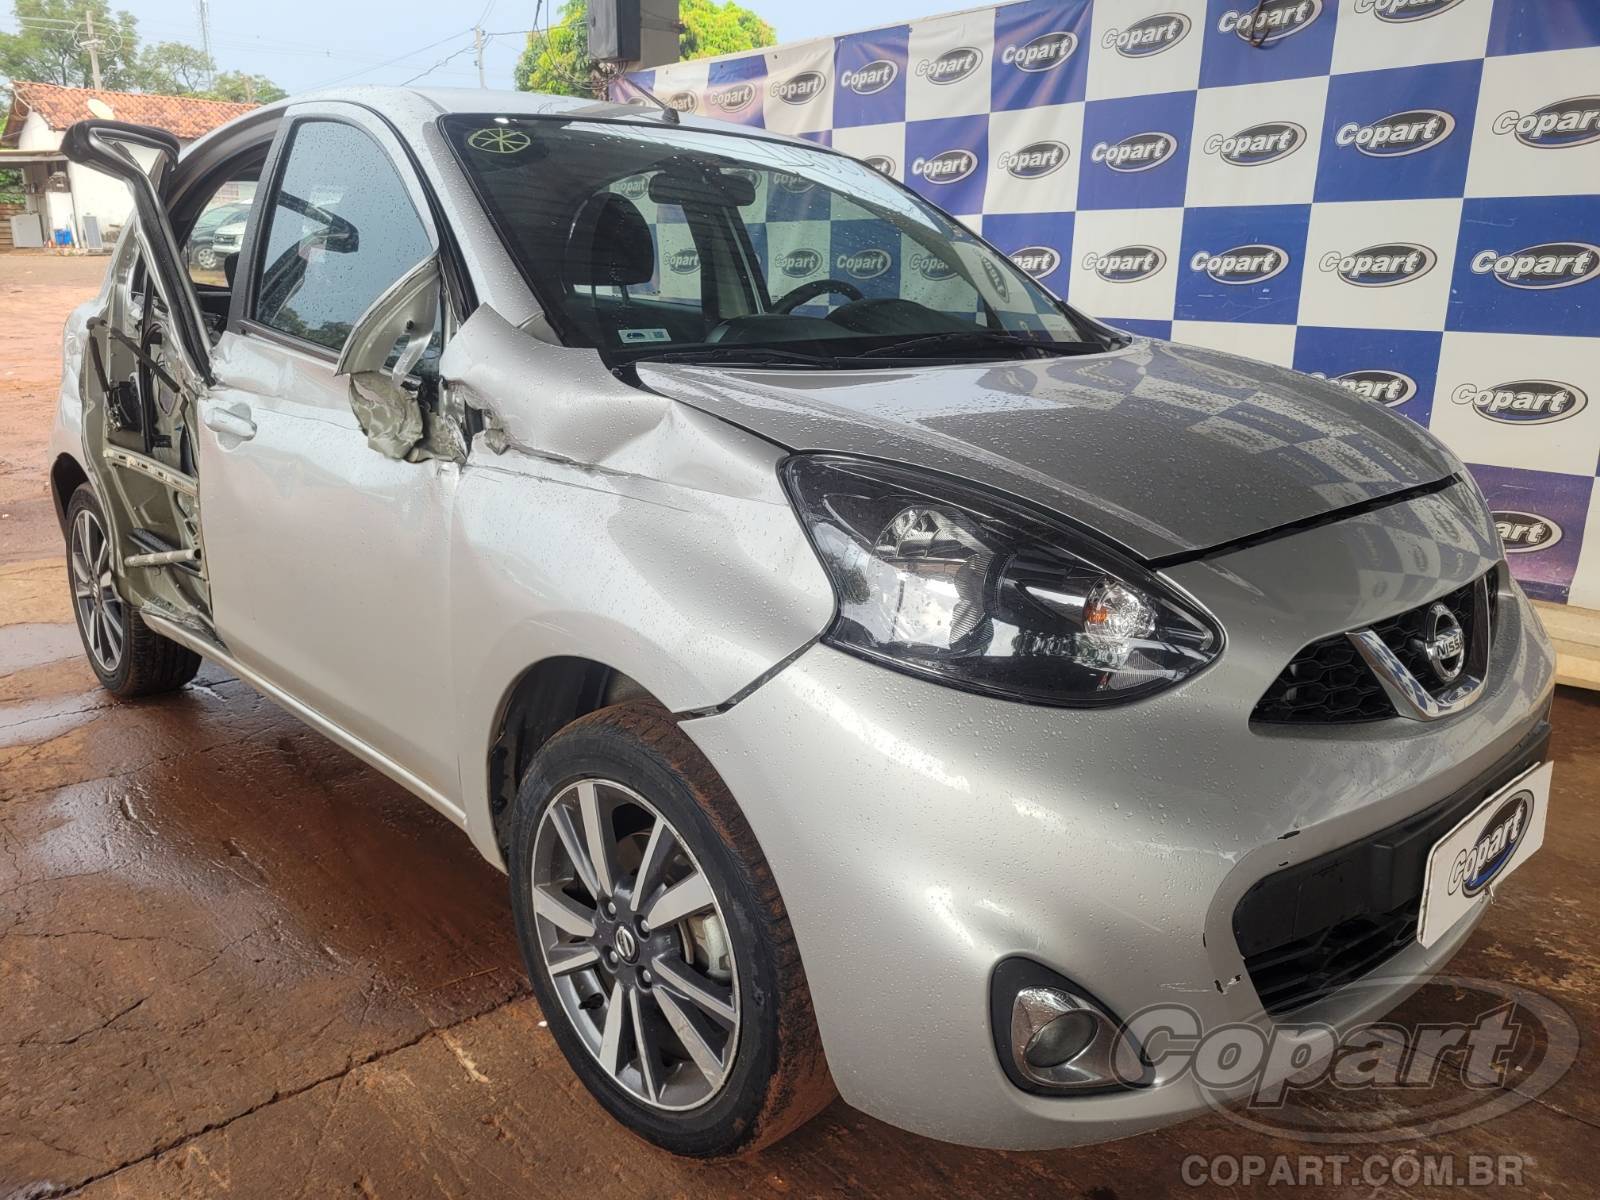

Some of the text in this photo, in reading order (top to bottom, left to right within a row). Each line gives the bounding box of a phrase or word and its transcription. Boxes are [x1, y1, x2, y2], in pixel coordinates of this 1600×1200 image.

[1101, 17, 1179, 50] Copart
[914, 51, 975, 78] Copart
[1002, 37, 1071, 67] Copart
[770, 75, 820, 97] Copart
[840, 66, 890, 92] Copart
[710, 87, 750, 106] Copart
[1203, 127, 1294, 159] Copart
[1335, 115, 1441, 150] Copart
[912, 153, 970, 176] Copart
[997, 145, 1060, 172] Copart
[1091, 137, 1167, 167] Copart
[775, 253, 816, 270] Copart
[836, 253, 884, 273] Copart
[910, 253, 949, 273] Copa
[1010, 252, 1051, 271] part
[1082, 251, 1154, 274] Copart
[1191, 251, 1278, 277] Copart
[1318, 249, 1422, 279] Copart
[1470, 248, 1592, 281] Copart
[1451, 383, 1570, 413] Copart
[1495, 521, 1545, 545] art
[1448, 798, 1525, 896] Copart
